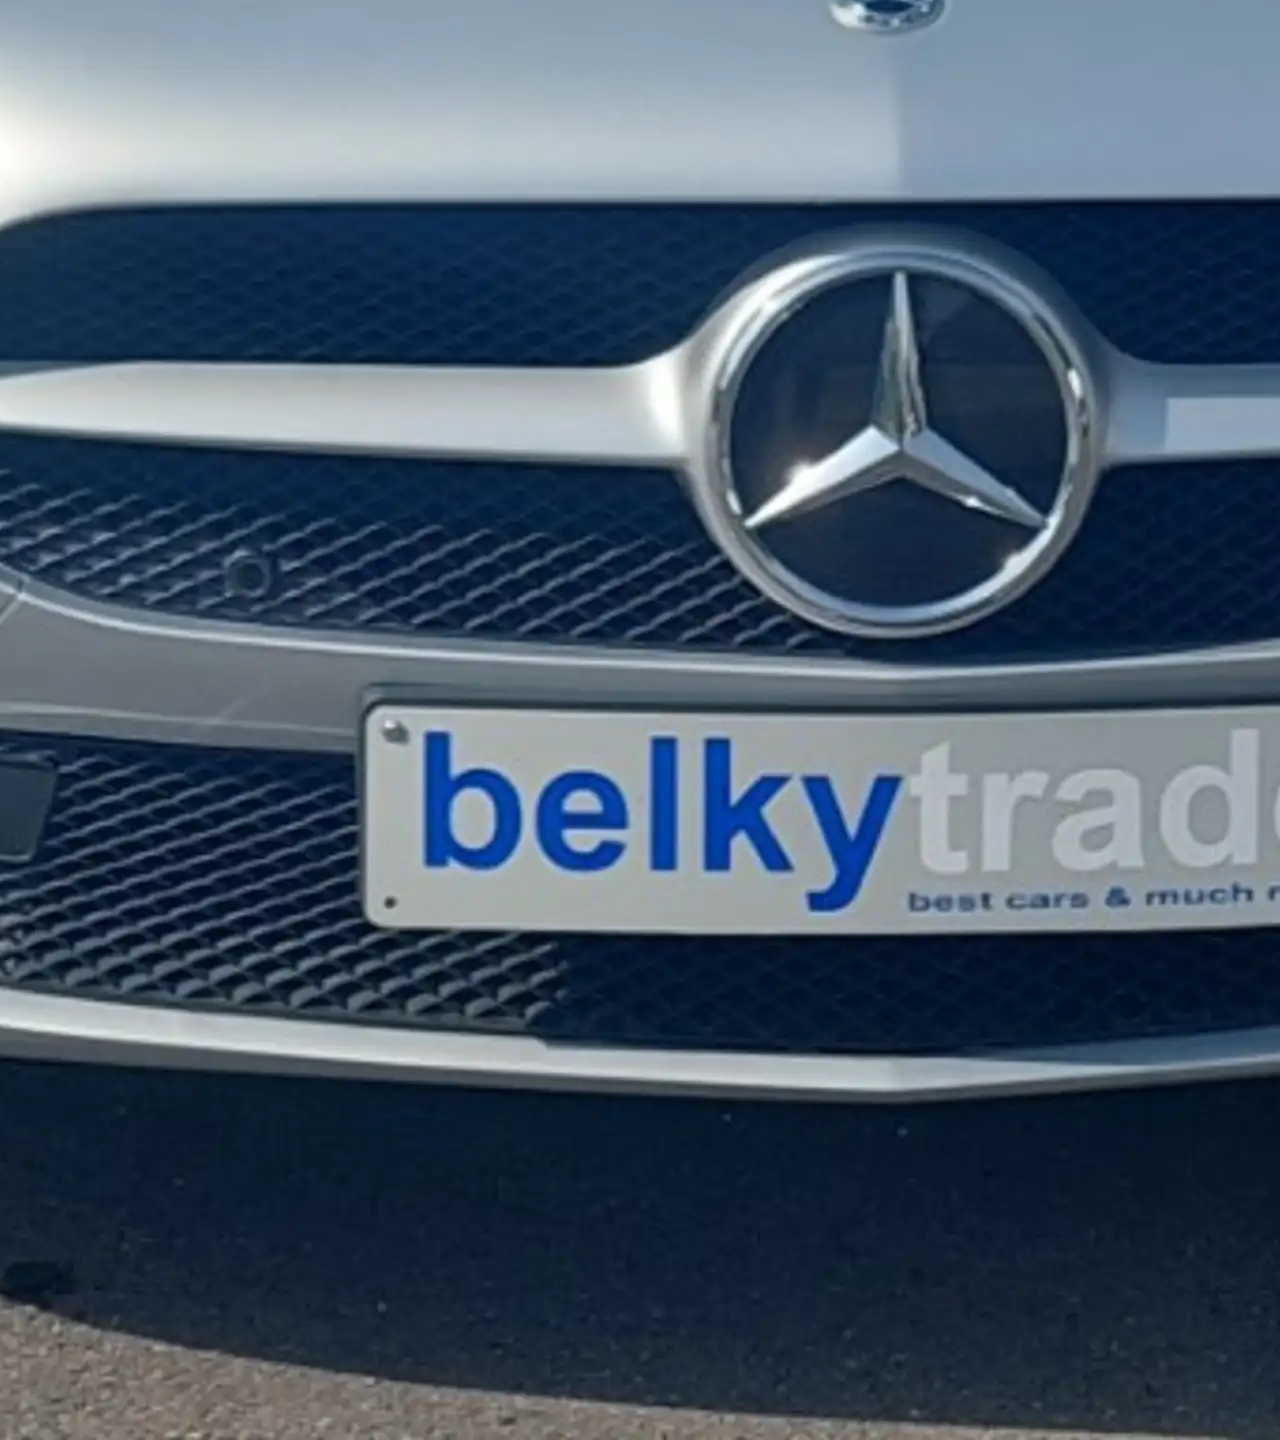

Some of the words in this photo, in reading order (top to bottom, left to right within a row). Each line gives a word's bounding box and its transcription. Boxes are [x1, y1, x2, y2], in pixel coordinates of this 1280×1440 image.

[908, 891, 993, 913] best
[1006, 892, 1090, 911] cars
[1104, 887, 1131, 908] &
[1145, 881, 1254, 907] much
